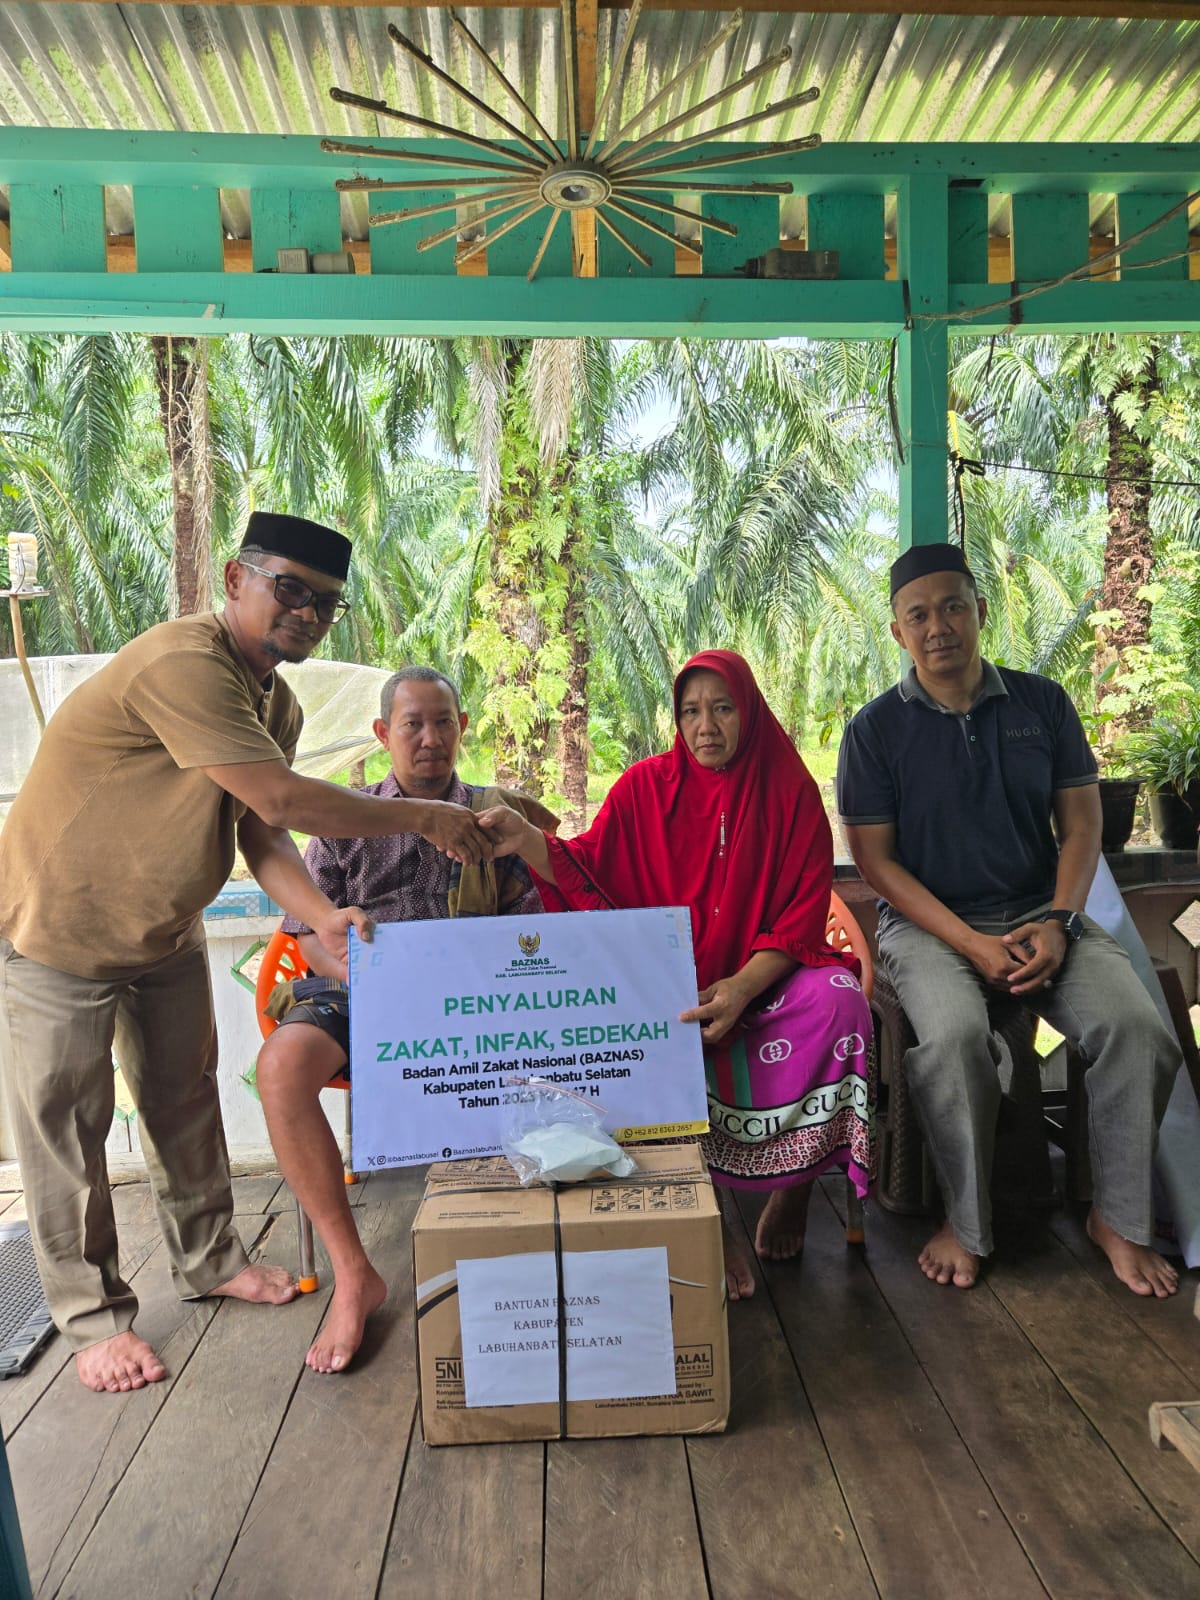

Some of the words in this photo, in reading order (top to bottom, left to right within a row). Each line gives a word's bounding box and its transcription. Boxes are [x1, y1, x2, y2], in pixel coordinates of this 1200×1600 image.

[1006, 726, 1041, 737] HUGO
[511, 958, 549, 966] BAZNAS
[444, 986, 617, 1017] PENYALURAN
[376, 1036, 469, 1063] ZAKAT,
[476, 1029, 556, 1055] INFAK,
[560, 1020, 670, 1048] SEDEKAH
[402, 1066, 446, 1080] Badan
[448, 1062, 480, 1076] Amil
[482, 1059, 520, 1073] Zakat
[522, 1054, 577, 1069] Nasional
[579, 1049, 645, 1066] (BAZNAS)
[423, 1079, 496, 1096] Kabupaten
[585, 1067, 631, 1081] Selatan
[458, 1096, 500, 1110] Tahun
[590, 1085, 600, 1097] H
[708, 1104, 782, 1138] UCCII
[494, 1298, 550, 1311] BANTUAN
[478, 1339, 560, 1354] LABUHANBAT
[567, 1335, 623, 1349] SELATAN
[675, 1353, 710, 1365] ALAL
[435, 1361, 462, 1379] SNI
[685, 1388, 713, 1398] SAWIT
